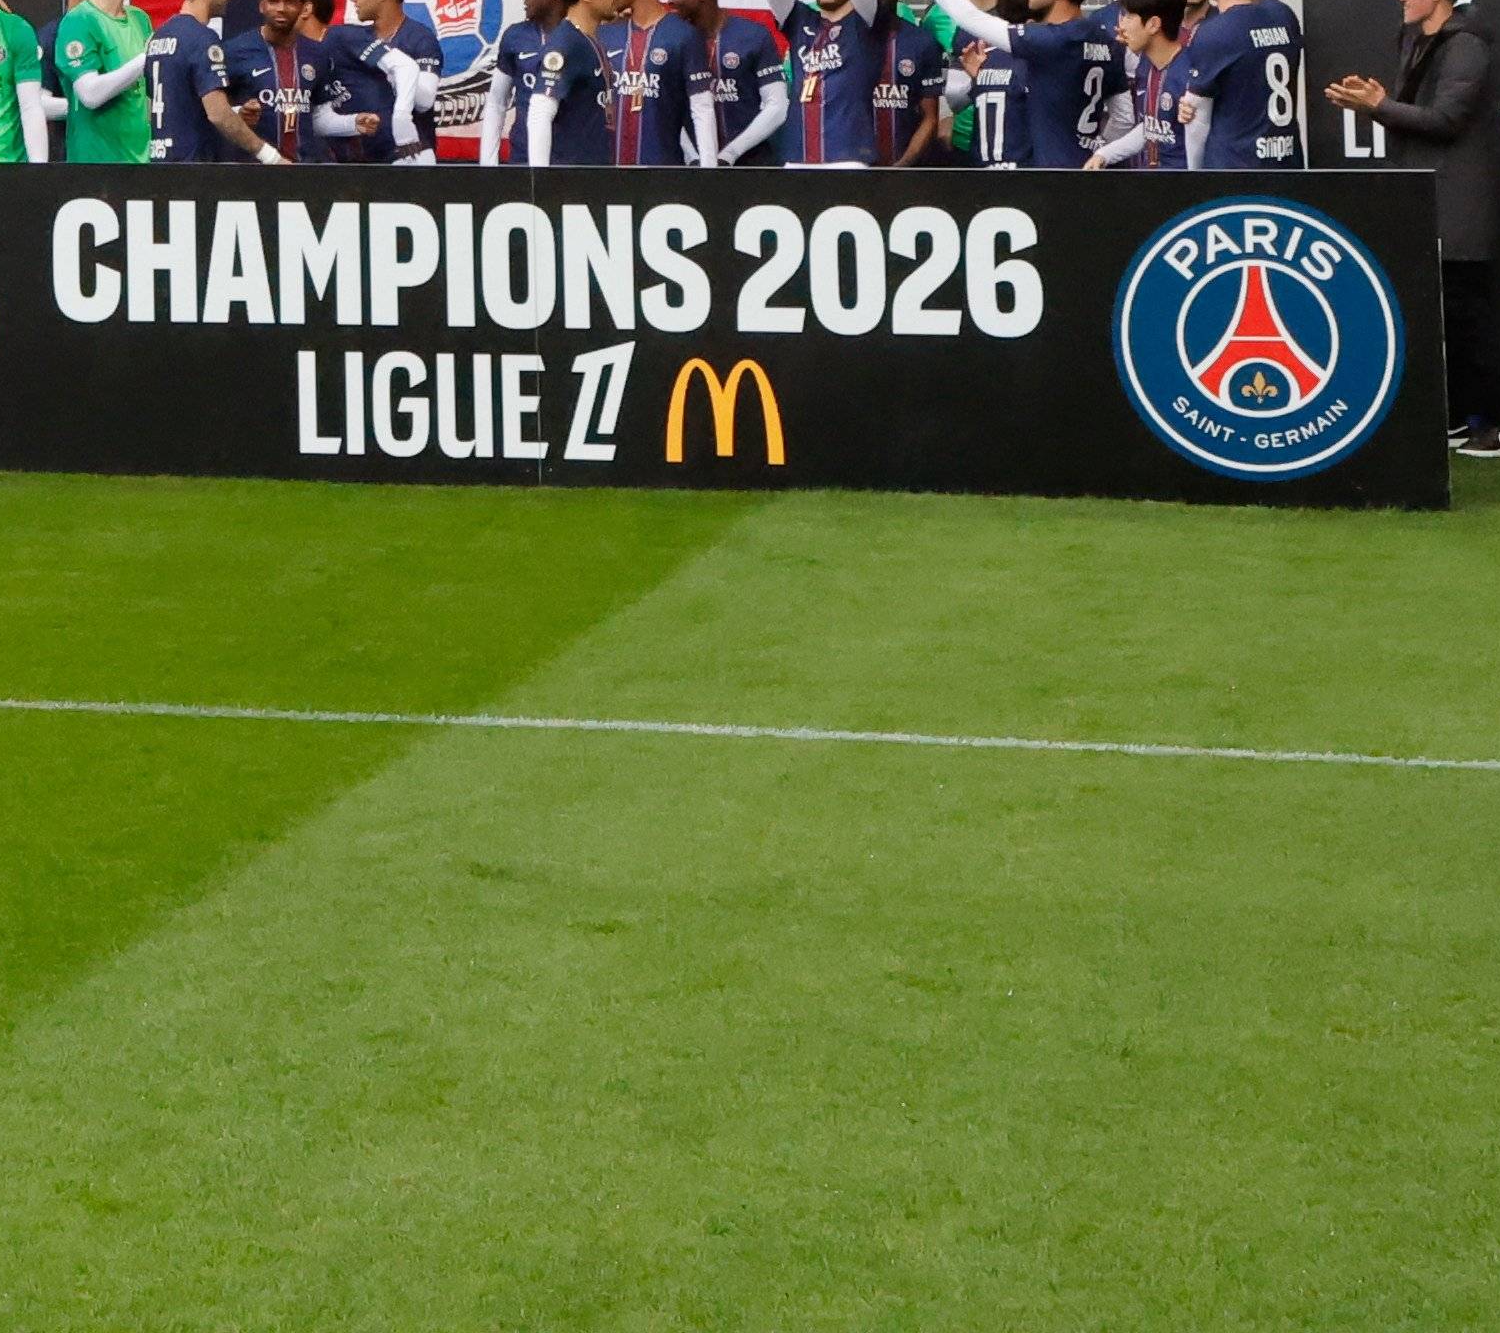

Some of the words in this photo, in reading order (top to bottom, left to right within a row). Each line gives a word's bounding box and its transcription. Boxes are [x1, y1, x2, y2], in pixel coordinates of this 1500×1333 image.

[258, 88, 310, 108] QATAR
[872, 84, 909, 100] ATAR
[1076, 66, 1104, 135] 2
[1264, 52, 1293, 127] 8
[51, 197, 711, 333] CHAMPIONS
[733, 204, 1044, 338] 2026
[1162, 218, 1342, 281] PARIS
[297, 349, 548, 459] LIGUE
[1171, 395, 1236, 443] SAINT
[1254, 398, 1349, 449] GERMAIN
